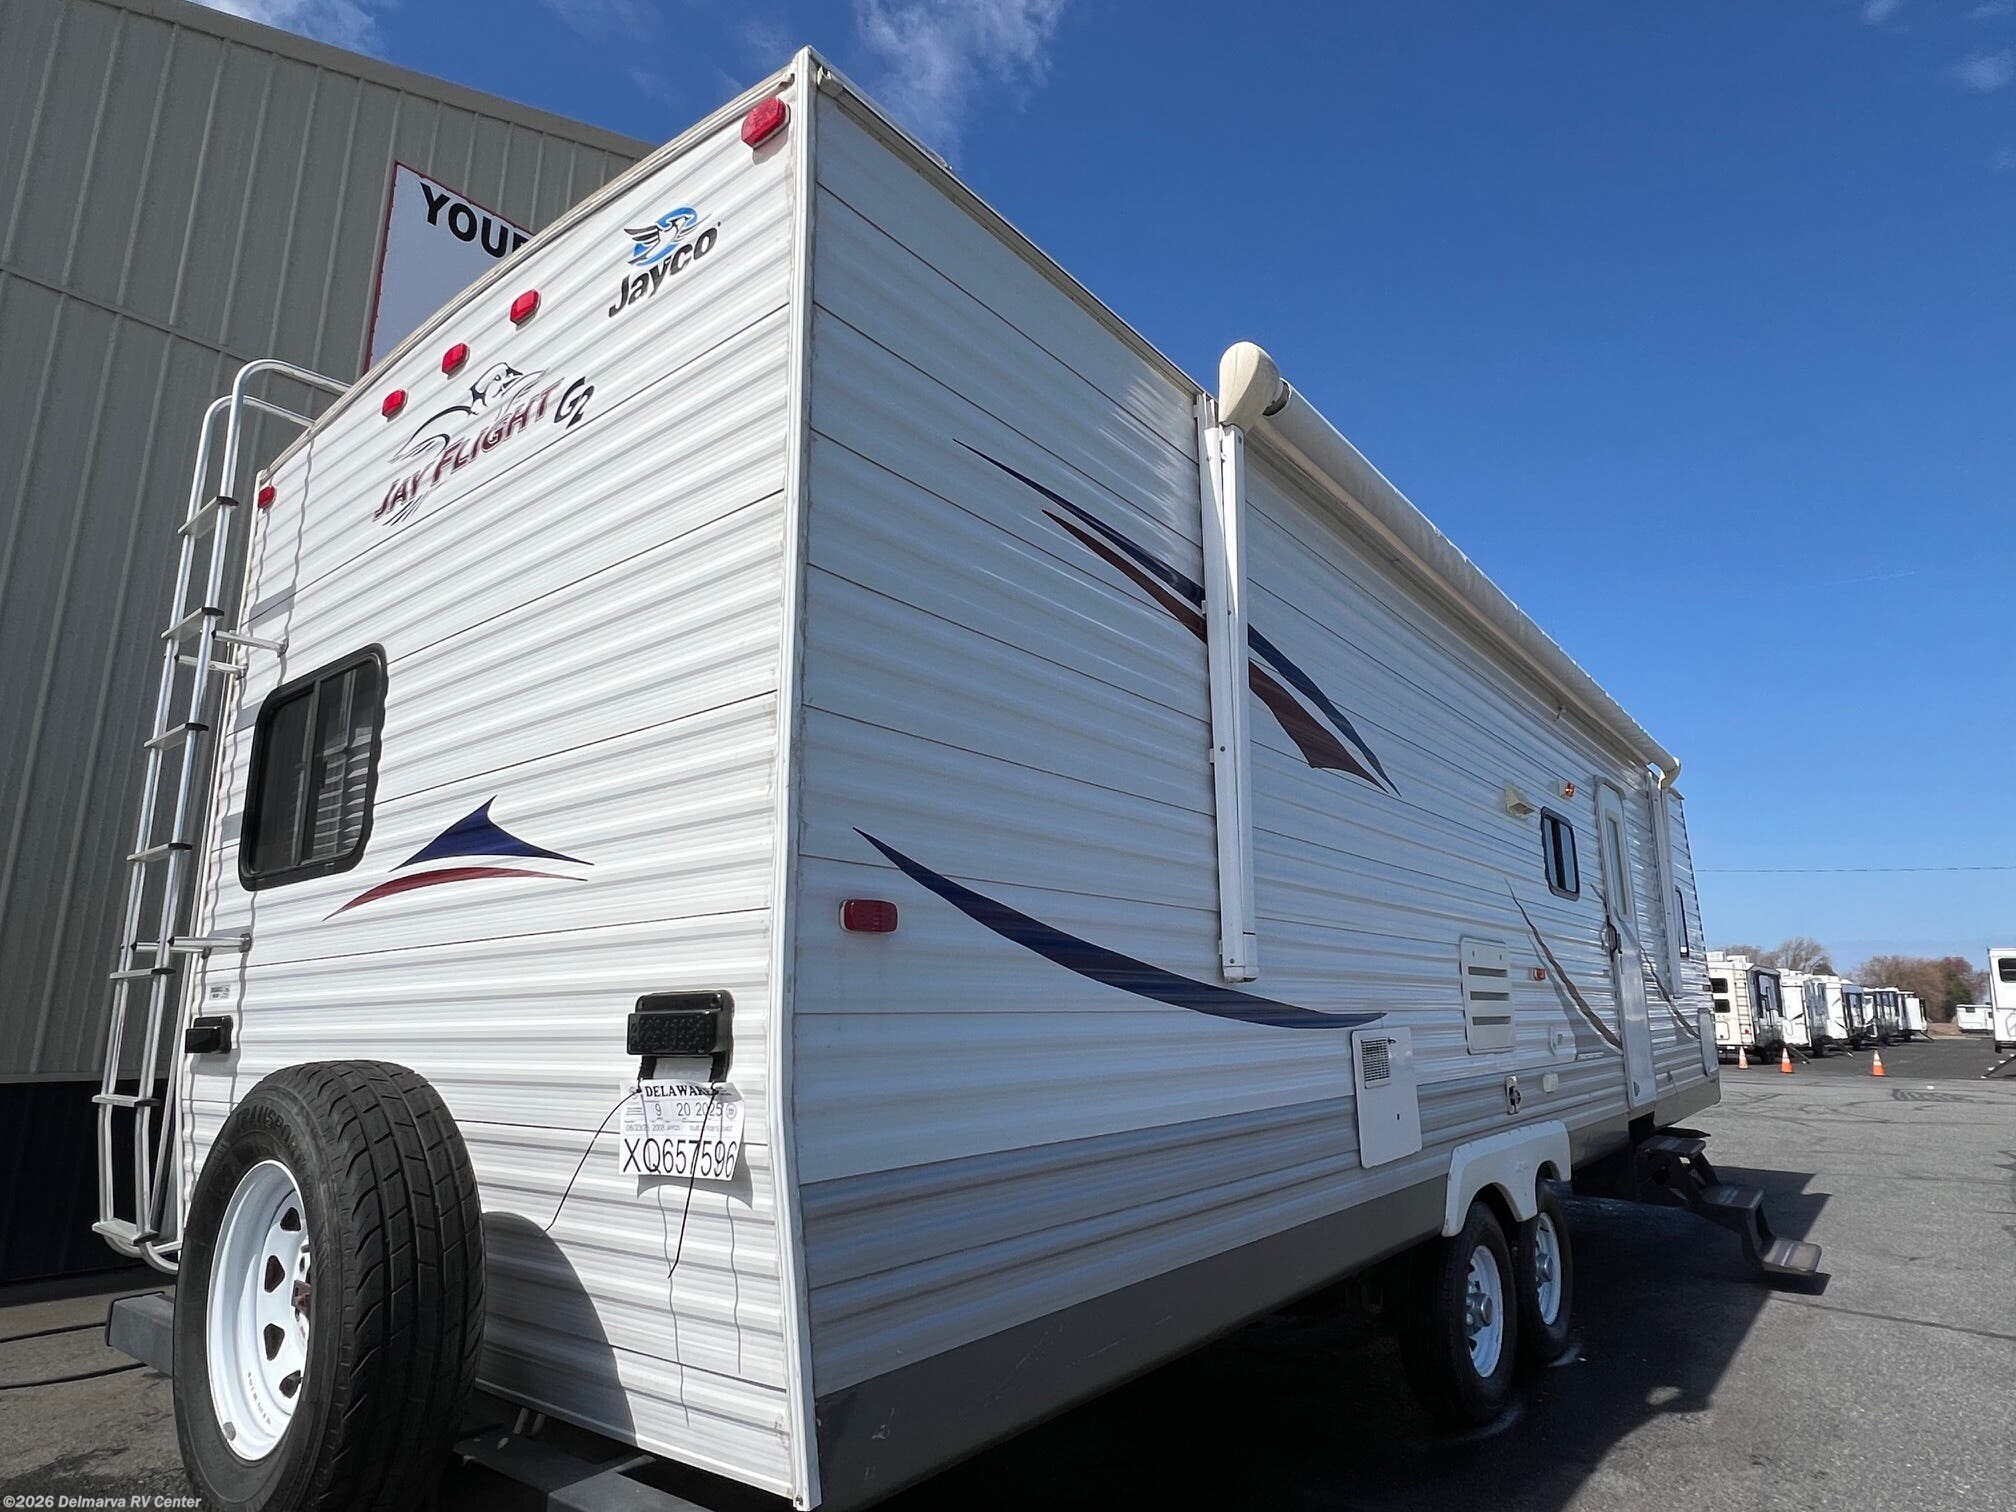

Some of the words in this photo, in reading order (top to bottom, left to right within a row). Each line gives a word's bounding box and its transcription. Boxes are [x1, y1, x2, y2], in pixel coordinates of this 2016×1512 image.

[608, 227, 718, 318] Jayco
[372, 462, 436, 522] JAY
[431, 378, 566, 487] FLIGHT
[553, 376, 595, 430] G2
[655, 1103, 662, 1117] 9
[676, 1102, 691, 1117] 20
[695, 1102, 723, 1117] 2025
[622, 1137, 738, 1180] XQ657596
